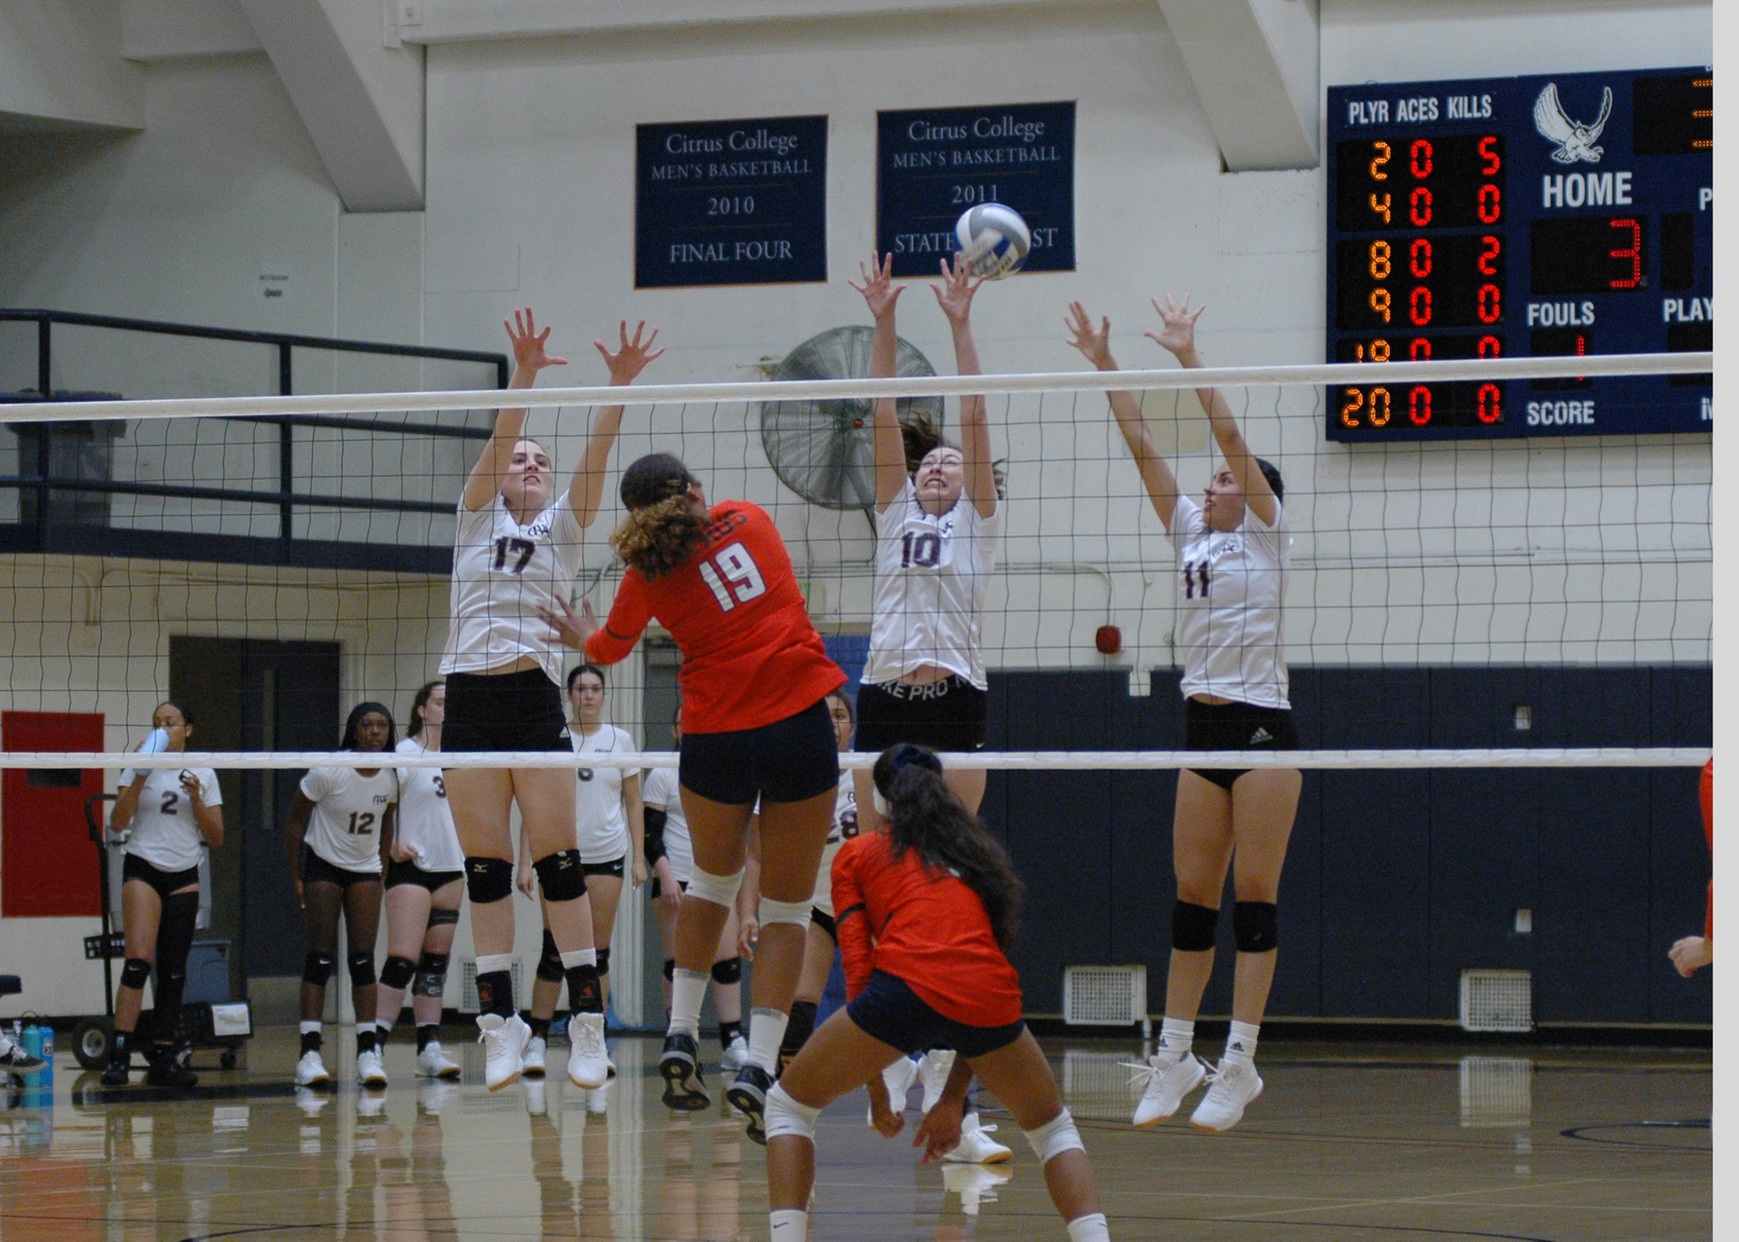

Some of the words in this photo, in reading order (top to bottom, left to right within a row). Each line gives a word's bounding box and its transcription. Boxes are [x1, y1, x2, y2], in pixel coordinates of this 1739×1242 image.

[1349, 100, 1389, 124] PLYR
[1397, 98, 1439, 121] ACES
[1448, 95, 1492, 118] KILLS
[666, 133, 723, 153] Citrus
[729, 129, 798, 155] College
[909, 120, 967, 141] Citrus
[974, 115, 1045, 142] College
[652, 164, 702, 180] MEN'S
[709, 159, 812, 177] BASKETBALL
[894, 150, 946, 168] MEN'S
[953, 146, 1060, 165] BASKETBALL
[1370, 141, 1391, 180] 2
[1411, 138, 1433, 179] 0
[1478, 135, 1500, 176] 5
[953, 184, 998, 203] 2011
[1543, 171, 1633, 208] HOME
[708, 196, 755, 215] 2010
[1370, 193, 1391, 224] 4
[1411, 186, 1432, 227] 0
[1478, 184, 1500, 224] 0
[670, 243, 730, 262] FINAL
[735, 240, 793, 260] FOUR
[1369, 240, 1391, 280] 8
[1411, 238, 1432, 278] 0
[1478, 235, 1500, 275] 2
[1610, 219, 1641, 288] 3
[1370, 288, 1391, 323] 9
[1411, 286, 1432, 326] 0
[1478, 283, 1500, 323] 0
[1527, 301, 1596, 327] FOULS
[1342, 387, 1391, 427] 20
[1410, 386, 1432, 426] 0
[1478, 383, 1500, 424] 0
[1527, 400, 1596, 426] SCORE
[494, 536, 535, 575] 17
[901, 531, 941, 568] 10
[698, 541, 767, 614] 19
[1184, 561, 1210, 599] 11
[908, 679, 949, 701] PRO
[432, 775, 447, 799] 3
[160, 790, 179, 816] 2
[349, 811, 376, 836] 12
